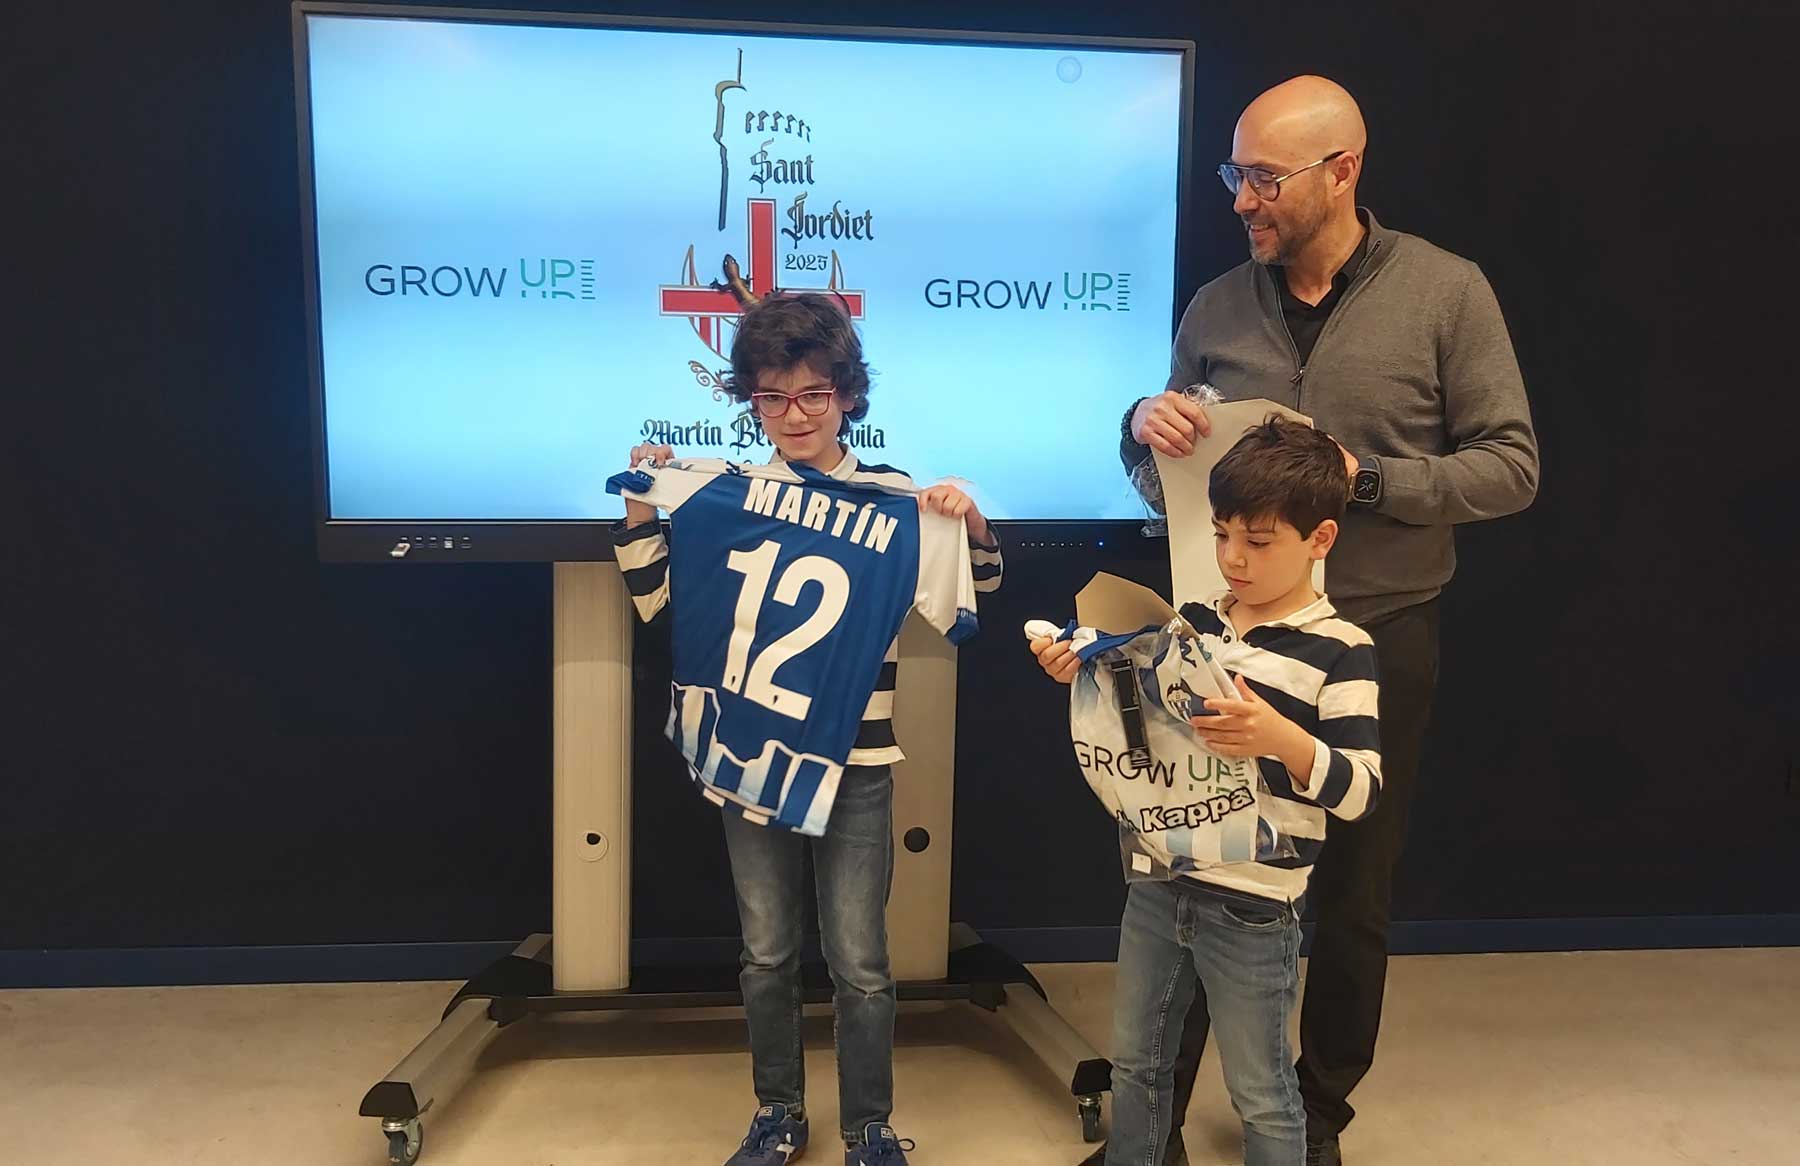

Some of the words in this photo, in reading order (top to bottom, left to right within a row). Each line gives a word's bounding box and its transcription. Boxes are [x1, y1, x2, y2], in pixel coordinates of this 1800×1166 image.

[750, 138, 815, 193] Sant
[781, 192, 874, 249] Jordiet
[365, 264, 507, 298] GROW
[785, 254, 828, 271] 2025
[924, 278, 1053, 310] GROW
[640, 418, 723, 447] Martín
[743, 478, 898, 554] MARTÍN
[721, 539, 850, 721] 12
[1074, 741, 1176, 788] GROW
[1140, 786, 1255, 833] Kappa
